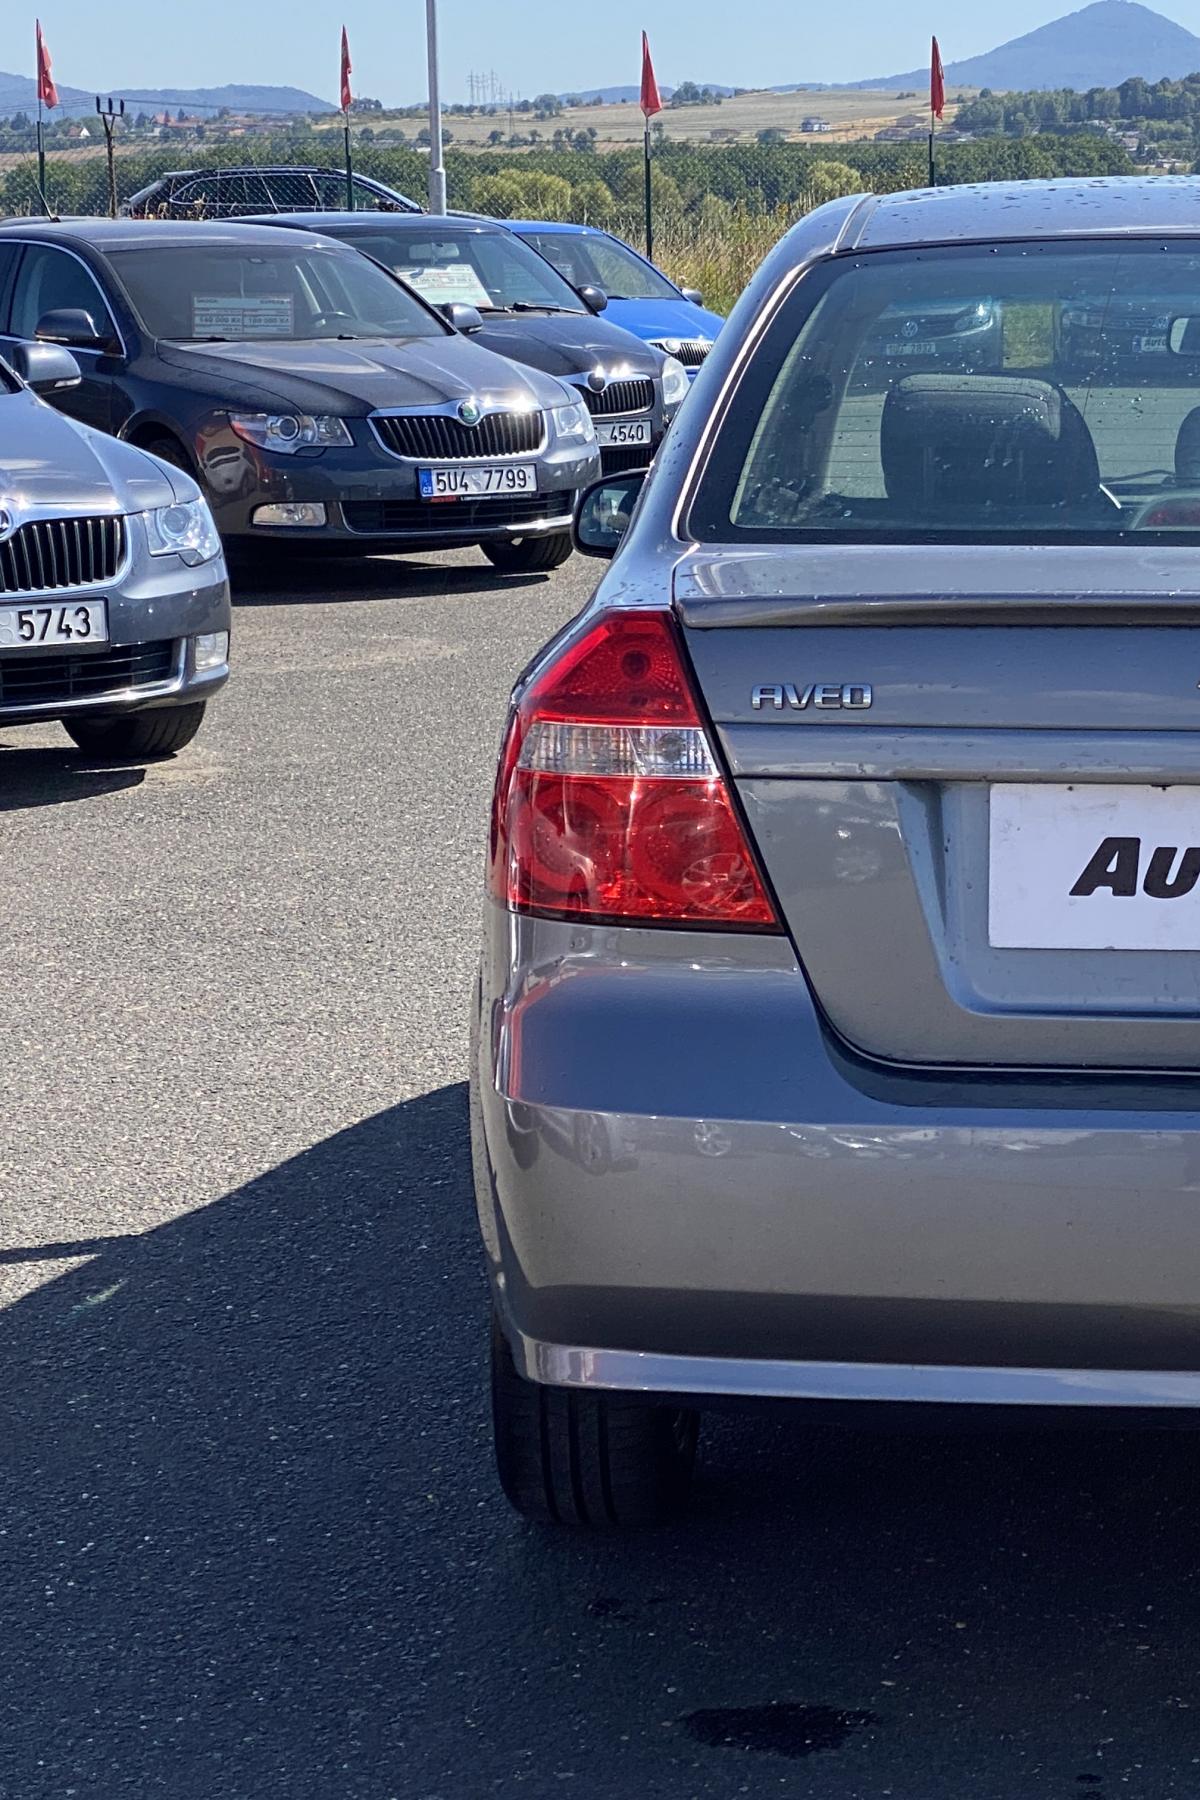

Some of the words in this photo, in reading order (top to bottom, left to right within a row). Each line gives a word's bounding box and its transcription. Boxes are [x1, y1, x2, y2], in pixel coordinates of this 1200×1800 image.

[610, 424, 644, 442] 4540
[436, 472, 469, 492] 5U4
[483, 469, 527, 491] 7799
[17, 606, 91, 641] 5743
[751, 682, 873, 711] AVEO
